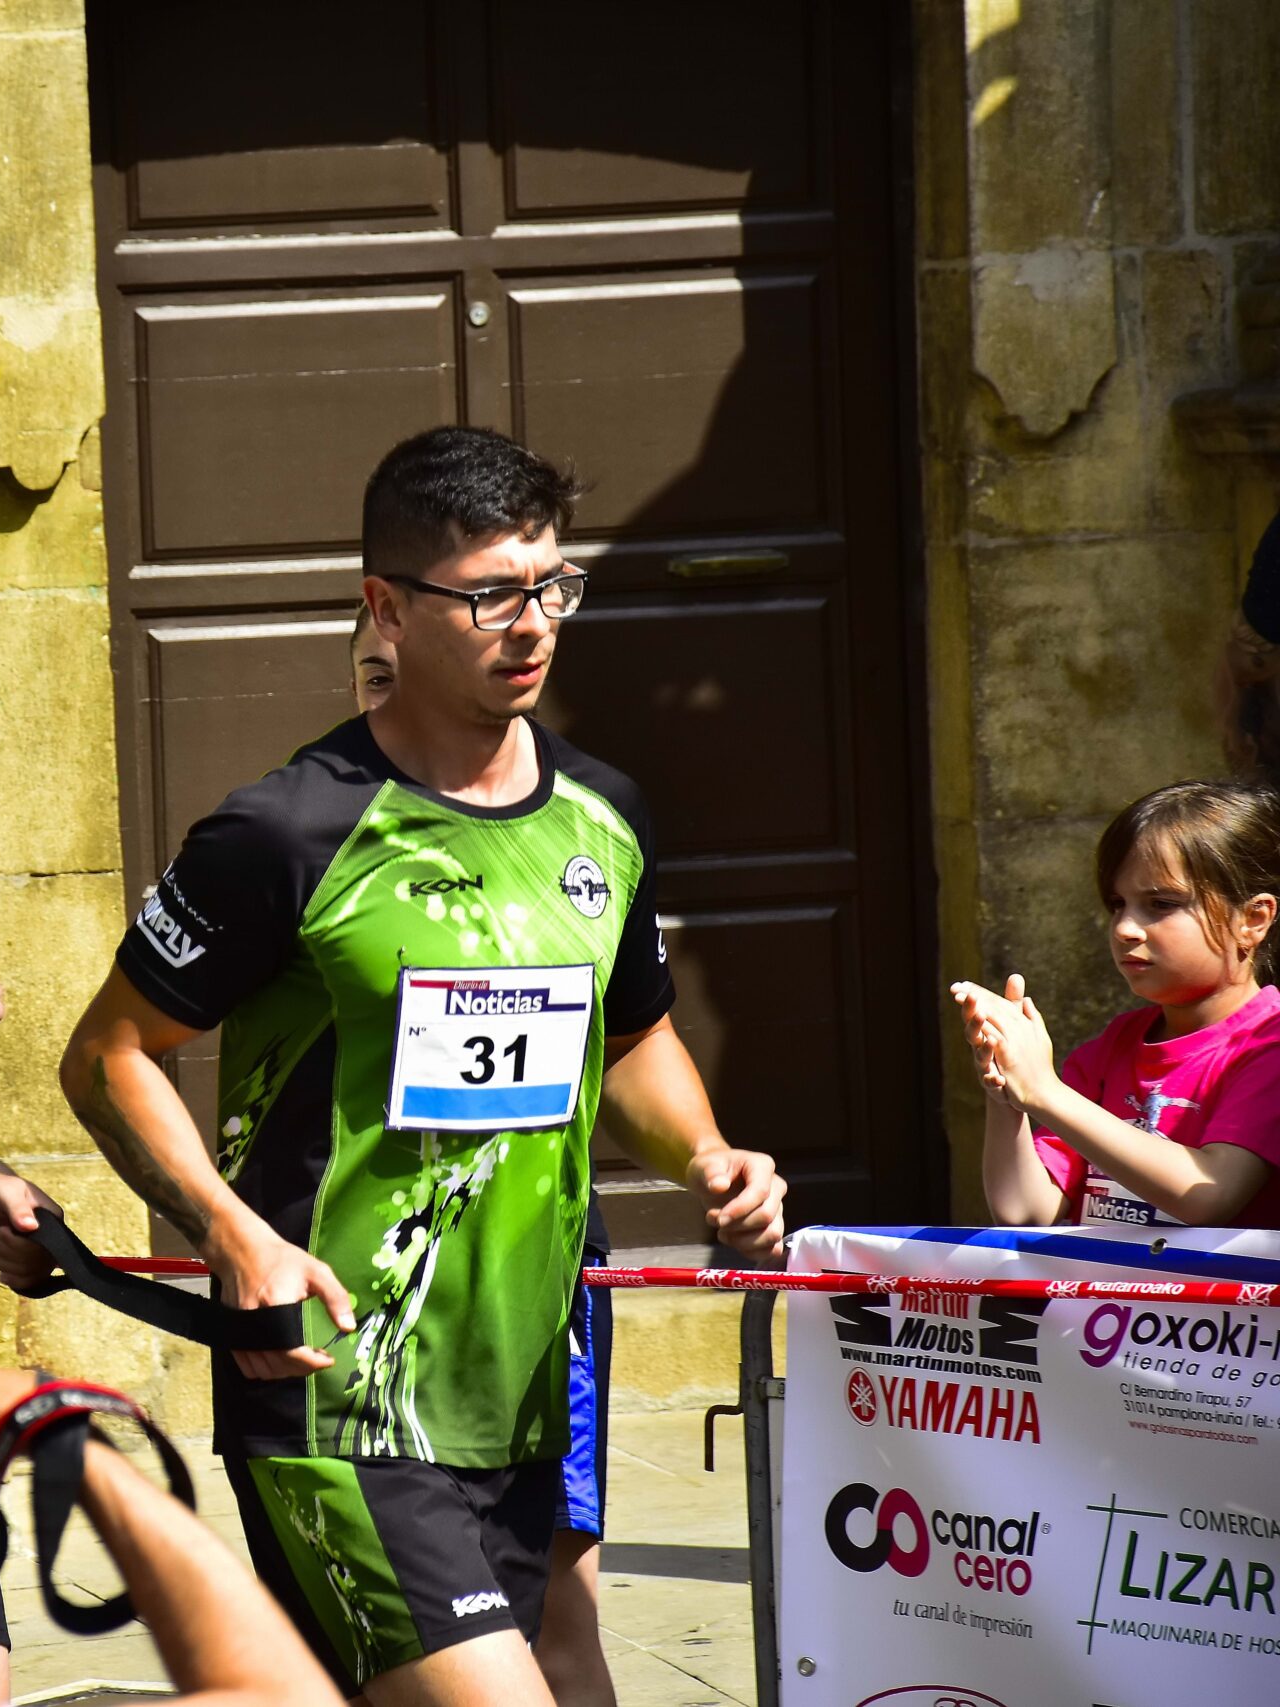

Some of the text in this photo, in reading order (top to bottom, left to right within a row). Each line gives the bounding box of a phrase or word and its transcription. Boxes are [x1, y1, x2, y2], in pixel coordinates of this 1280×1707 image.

[449, 989, 543, 1015] Noticias
[454, 980, 488, 990] Diario de
[460, 1034, 528, 1084] 31
[1088, 1196, 1149, 1224] Noticias
[1087, 1281, 1186, 1295] Nafarroako
[894, 1316, 974, 1355] Motos
[1079, 1302, 1280, 1368] goxoki-
[840, 1346, 1043, 1384] www.martinmotos.com
[1122, 1350, 1201, 1376] tienda
[1211, 1363, 1242, 1381] de
[878, 1374, 1041, 1445] YAMAHA
[1124, 1399, 1156, 1414] 31014
[1134, 1384, 1193, 1403] Bernardino
[1234, 1396, 1252, 1408] 57
[932, 1509, 1040, 1557] canal
[954, 1551, 1032, 1596] cero
[1120, 1530, 1276, 1615] LIZAR
[893, 1599, 1034, 1639] tu canal de impresión
[1110, 1619, 1218, 1648] MAQUINARIA
[1221, 1632, 1243, 1650] DE
